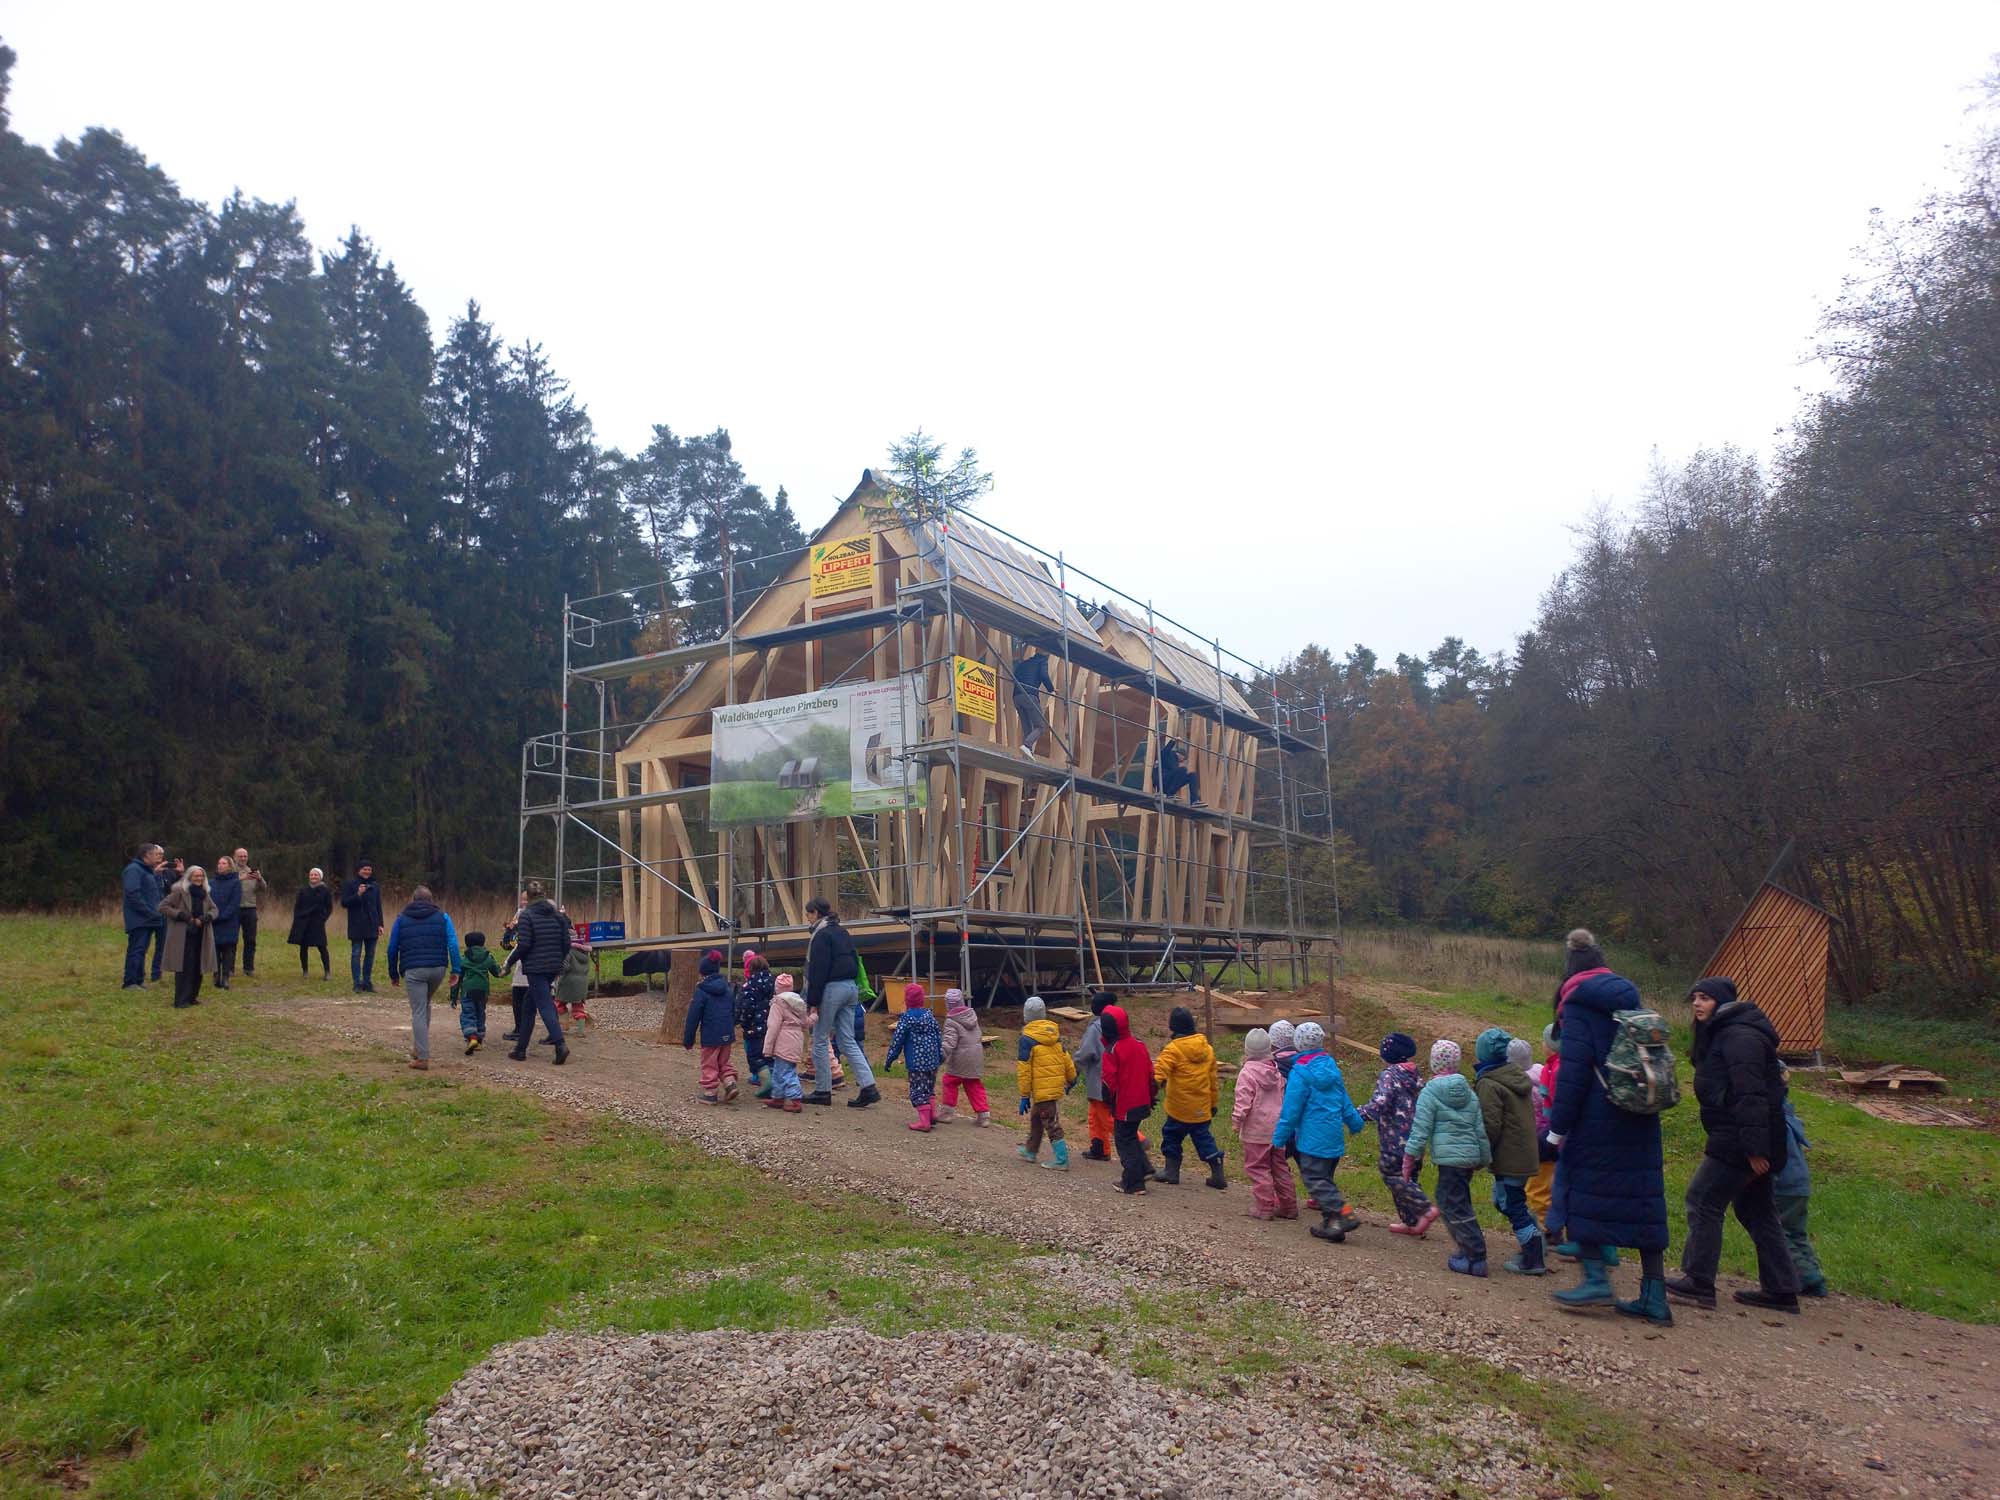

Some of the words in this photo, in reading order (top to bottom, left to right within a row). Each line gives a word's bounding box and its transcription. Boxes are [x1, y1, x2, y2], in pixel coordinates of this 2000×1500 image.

[823, 555, 870, 573] LIPFERT
[964, 681, 994, 700] LIPFERT
[719, 705, 796, 723] Waldkindergarten
[797, 698, 839, 712] Pinzberg
